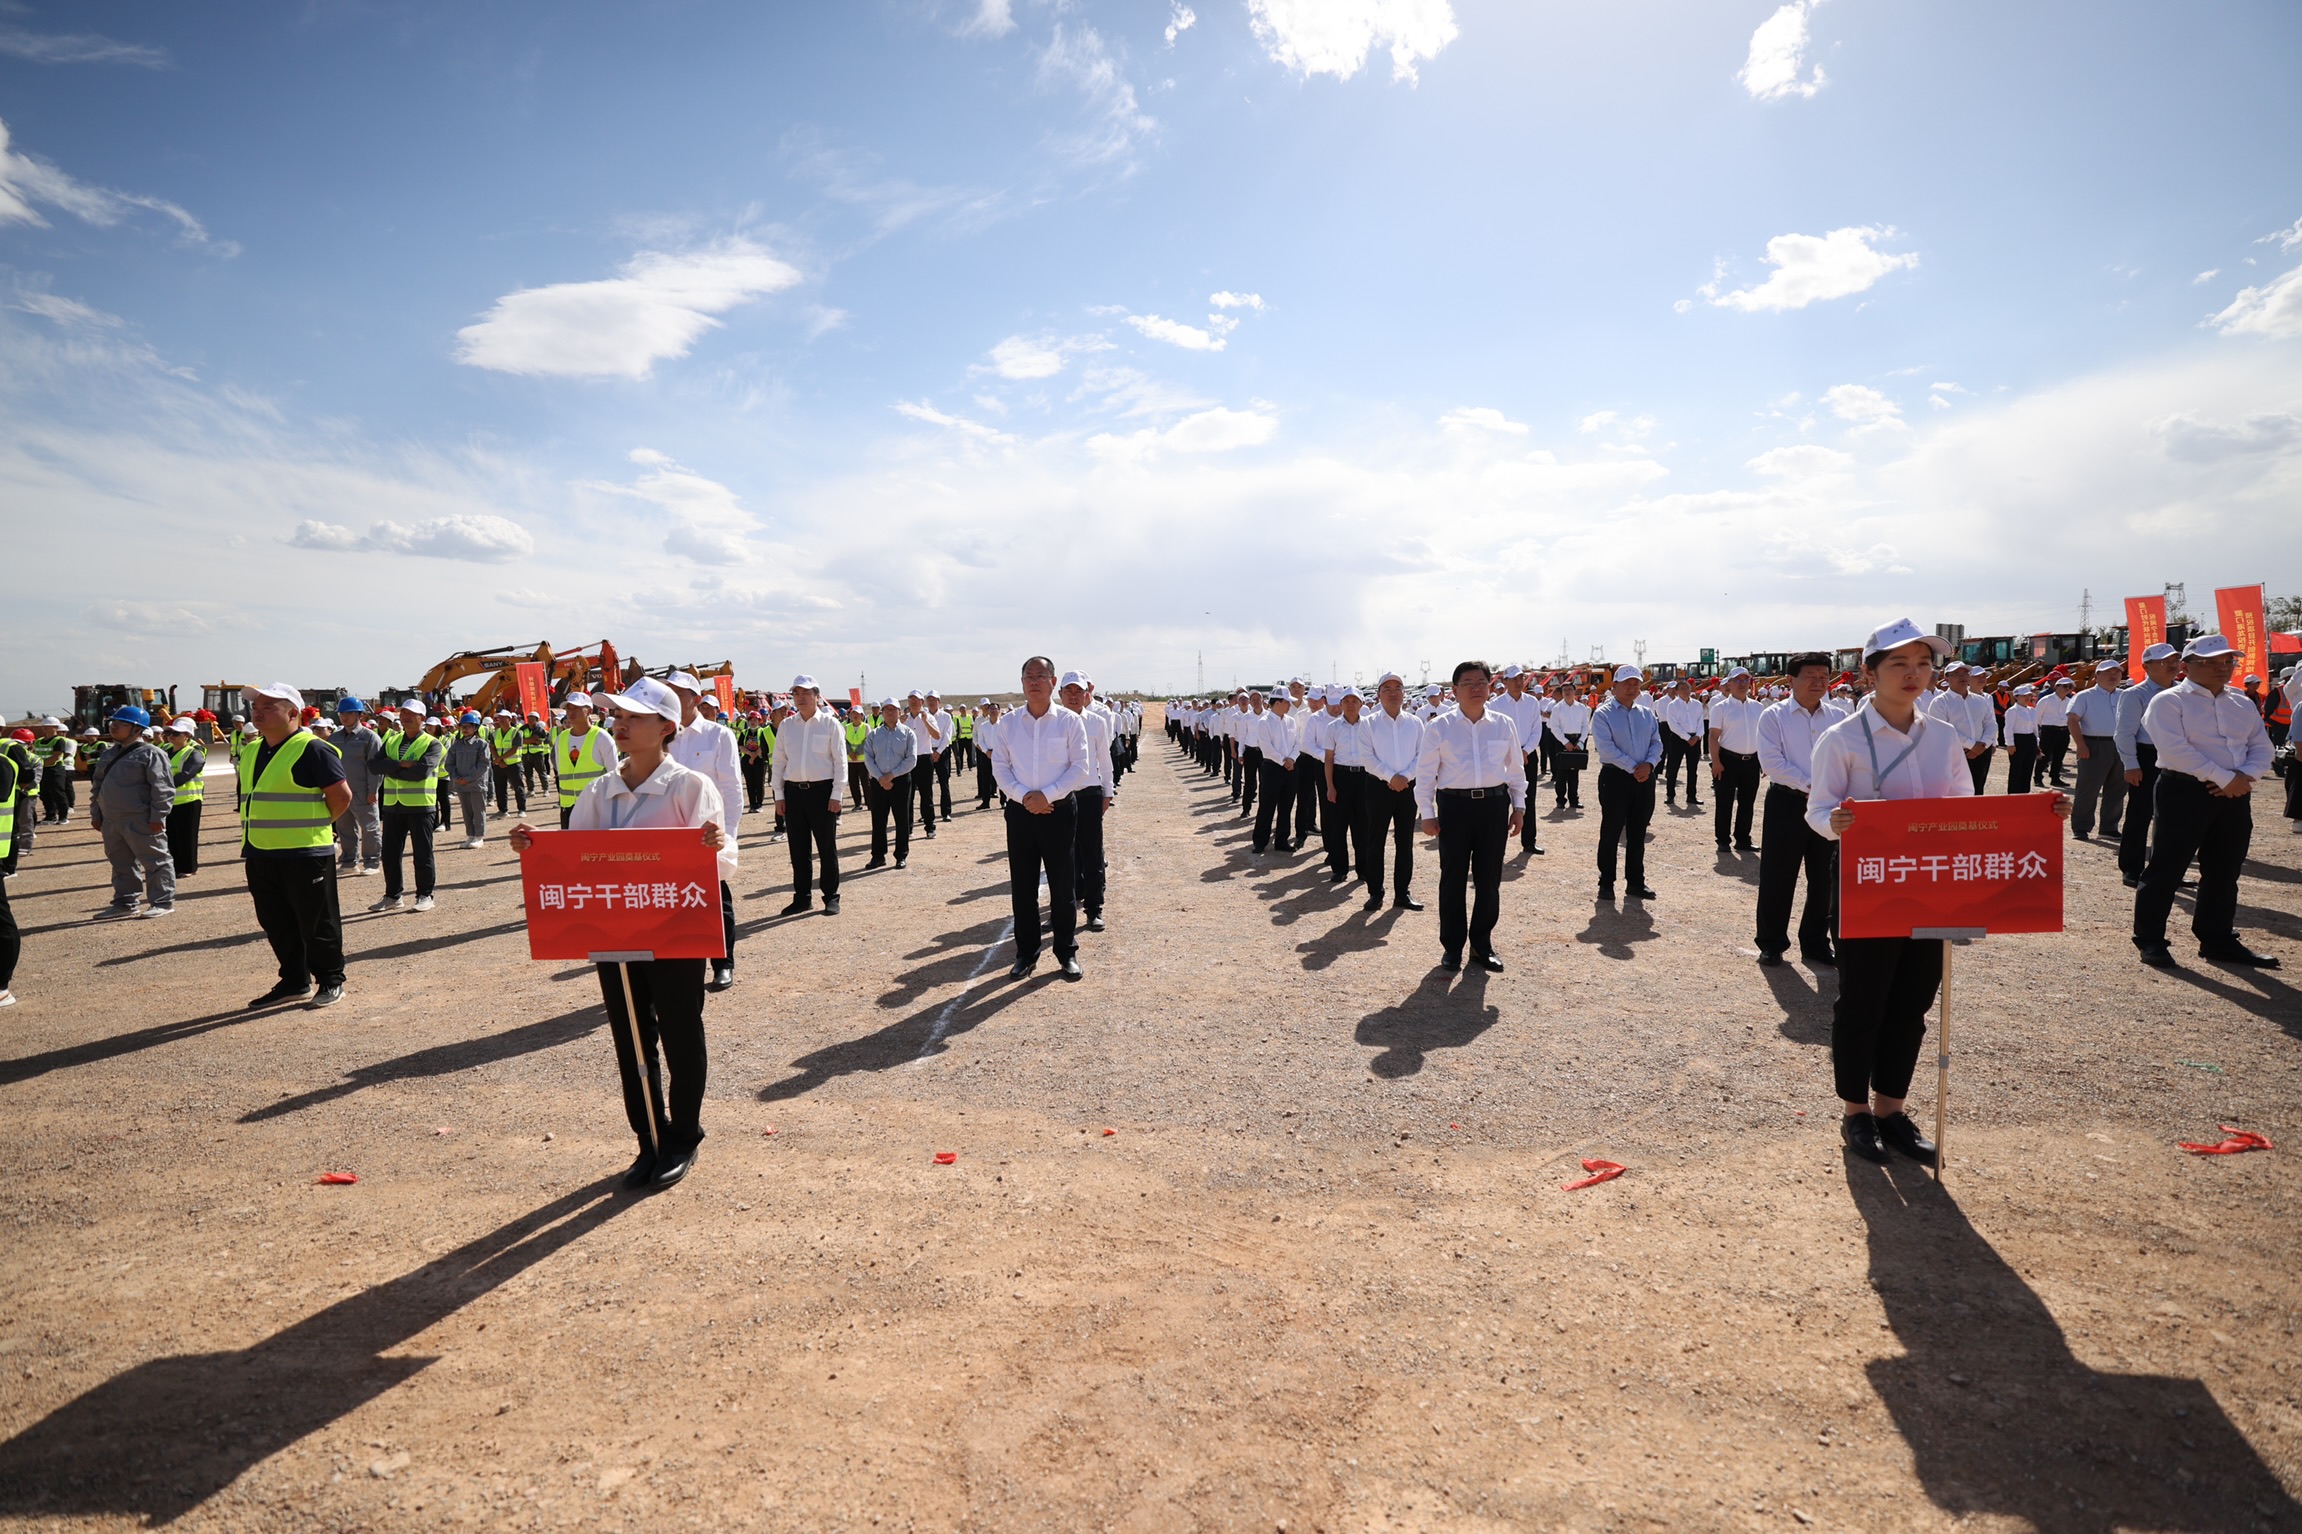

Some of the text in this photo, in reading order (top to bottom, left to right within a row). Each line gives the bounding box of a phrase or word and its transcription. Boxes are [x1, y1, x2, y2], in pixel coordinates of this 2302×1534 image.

[1907, 820, 1999, 833] 闽宁产业园奠基仪式
[580, 852, 661, 862] 闽宁产业园奠基仪式
[1856, 850, 2048, 885] 闽宁干部群众
[539, 881, 708, 910] 闽宁干部群众
